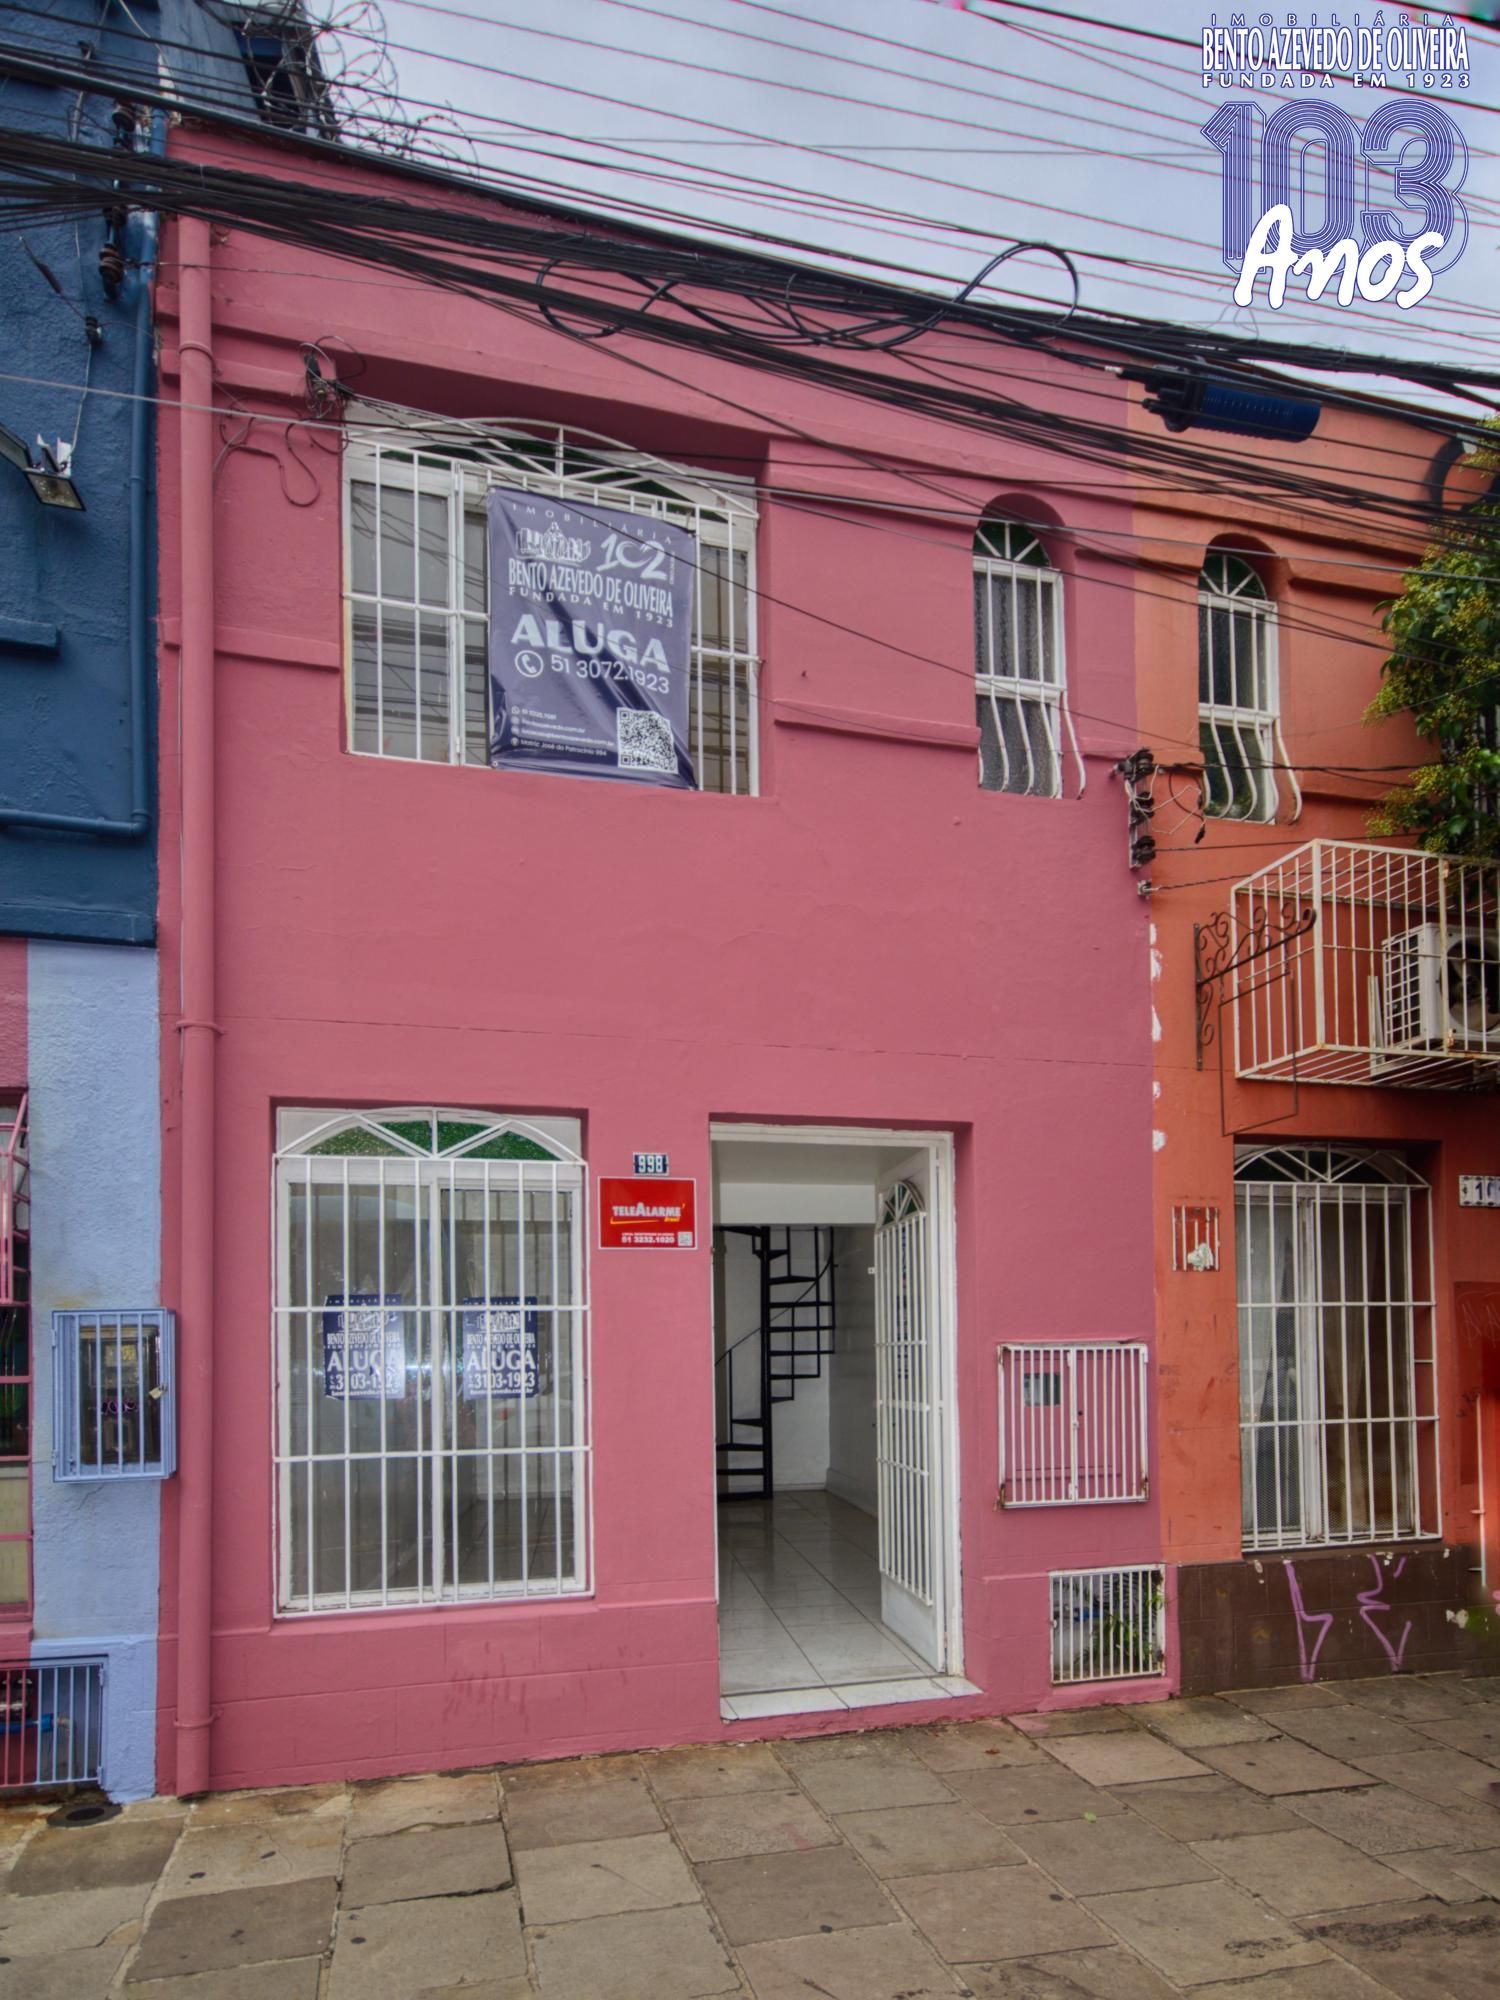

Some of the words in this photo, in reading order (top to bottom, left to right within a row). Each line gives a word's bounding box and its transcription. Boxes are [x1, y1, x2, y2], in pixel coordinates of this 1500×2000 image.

[596, 533, 668, 581] 102
[508, 557, 548, 592] BENTO
[550, 565, 604, 598] AZEVEDO
[606, 576, 622, 604] DE
[623, 580, 674, 618] OLIVEIRA
[508, 587, 593, 606] FUNDADA
[602, 604, 625, 615] EM
[635, 612, 674, 628] 1923
[510, 613, 671, 674] ALUGA
[551, 654, 571, 675] 51
[575, 659, 670, 695] 3072.1923
[467, 1349, 536, 1371] ALUGA
